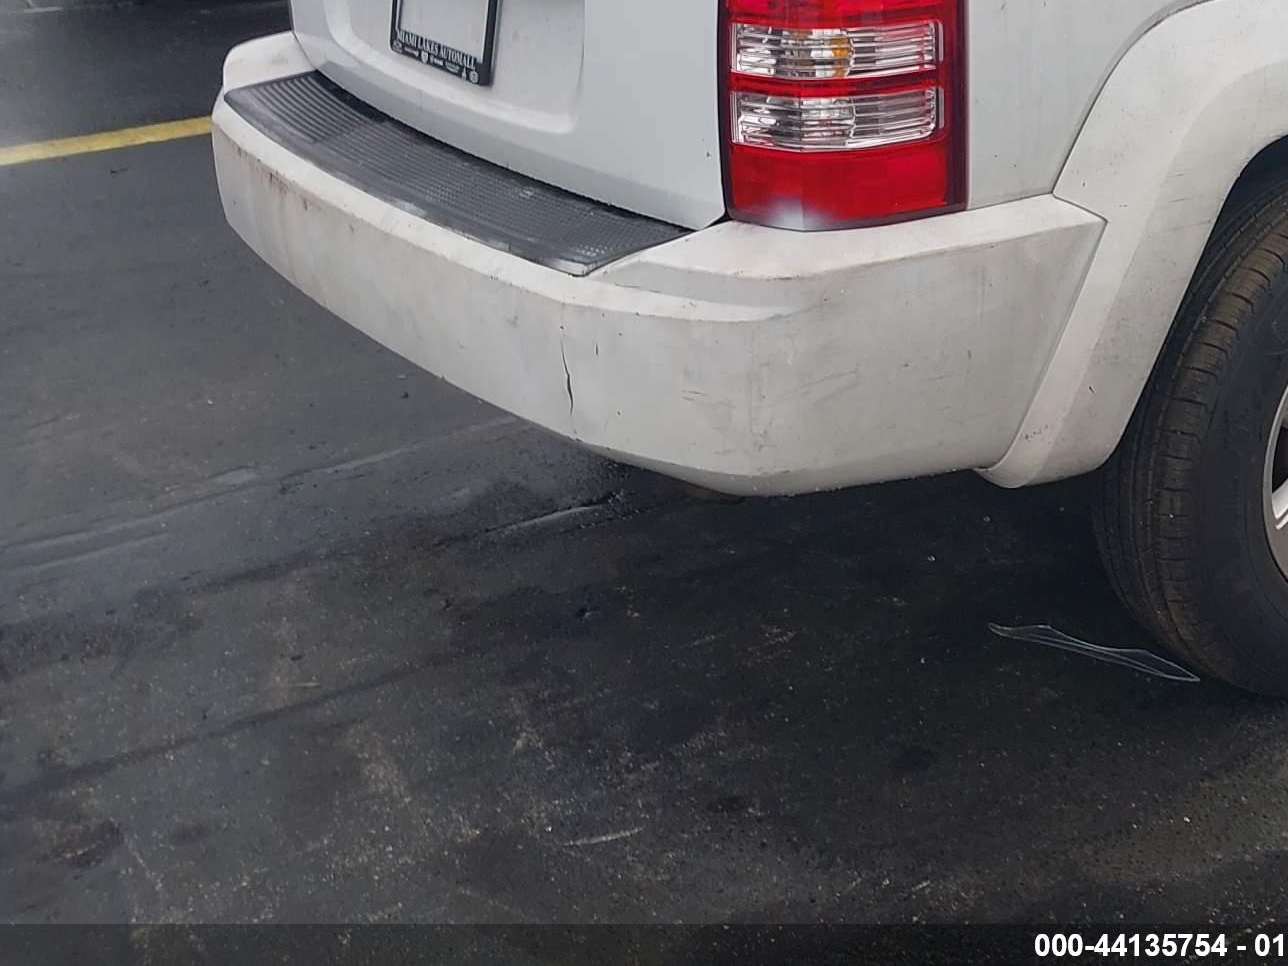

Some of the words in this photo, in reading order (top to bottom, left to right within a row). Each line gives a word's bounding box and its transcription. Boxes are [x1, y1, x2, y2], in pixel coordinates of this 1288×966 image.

[398, 30, 418, 49] MIAMI
[418, 37, 439, 56] LAKES
[438, 44, 476, 72] AUTOMALL
